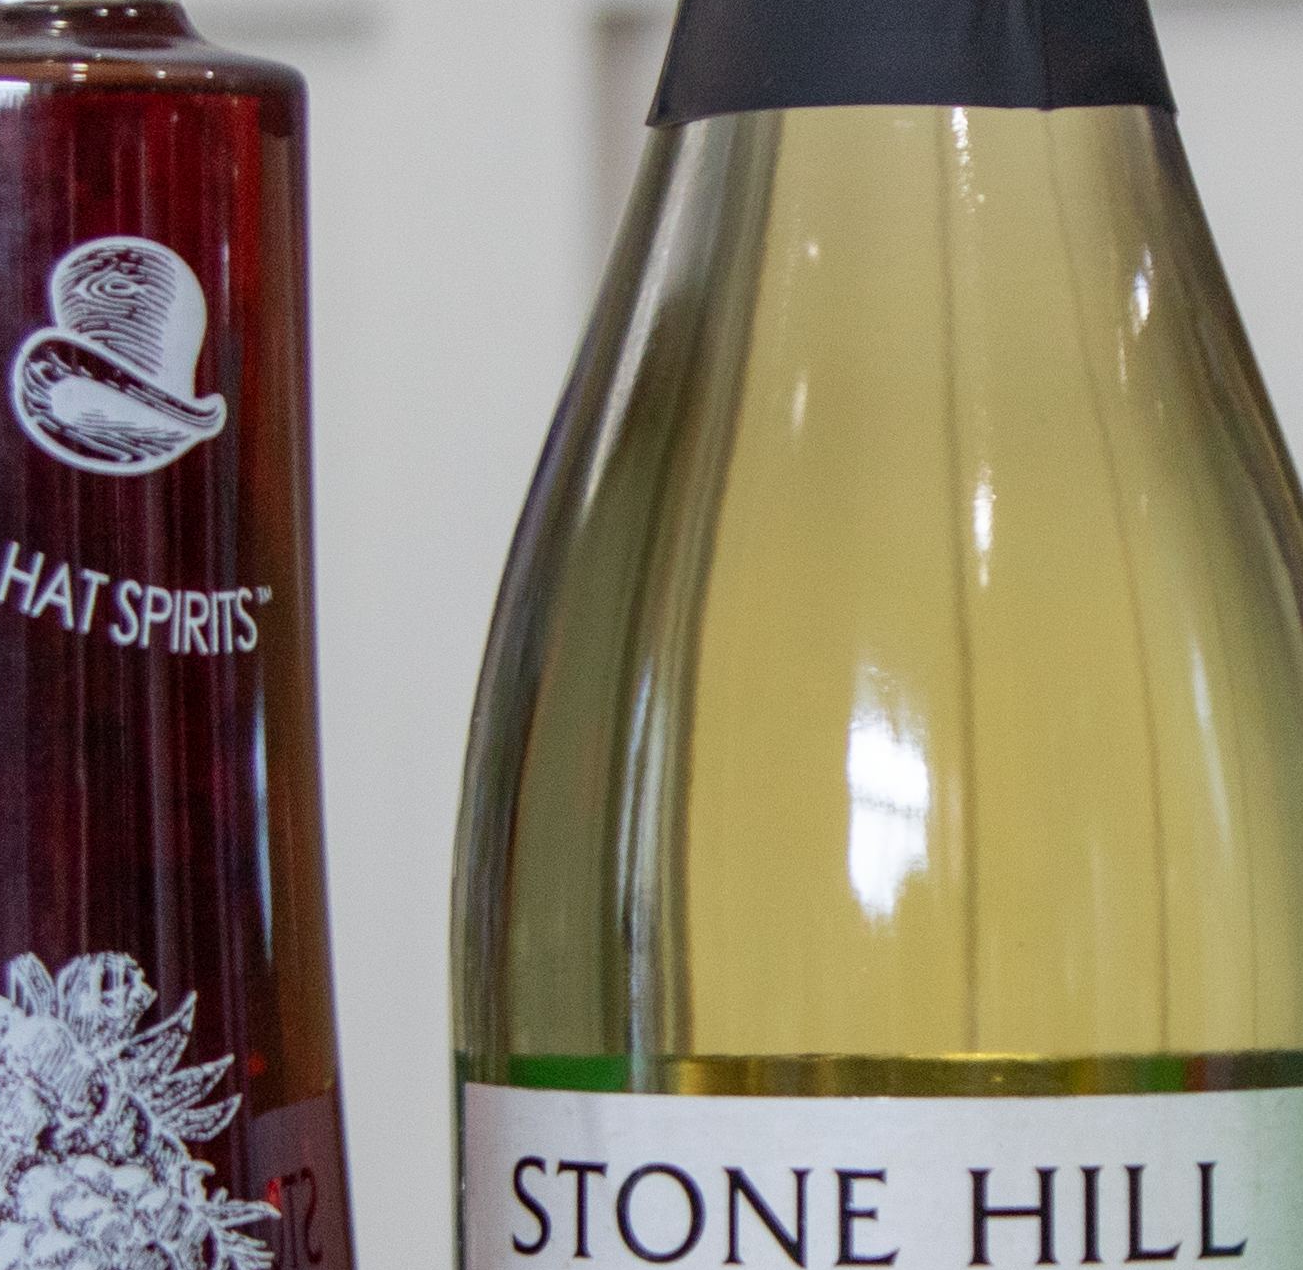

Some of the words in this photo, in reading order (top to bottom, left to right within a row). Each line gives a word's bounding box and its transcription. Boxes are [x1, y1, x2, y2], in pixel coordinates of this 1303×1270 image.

[111, 581, 258, 655] SPIRITS
[510, 1154, 900, 1269] STONE
[966, 1160, 1250, 1268] HILL
